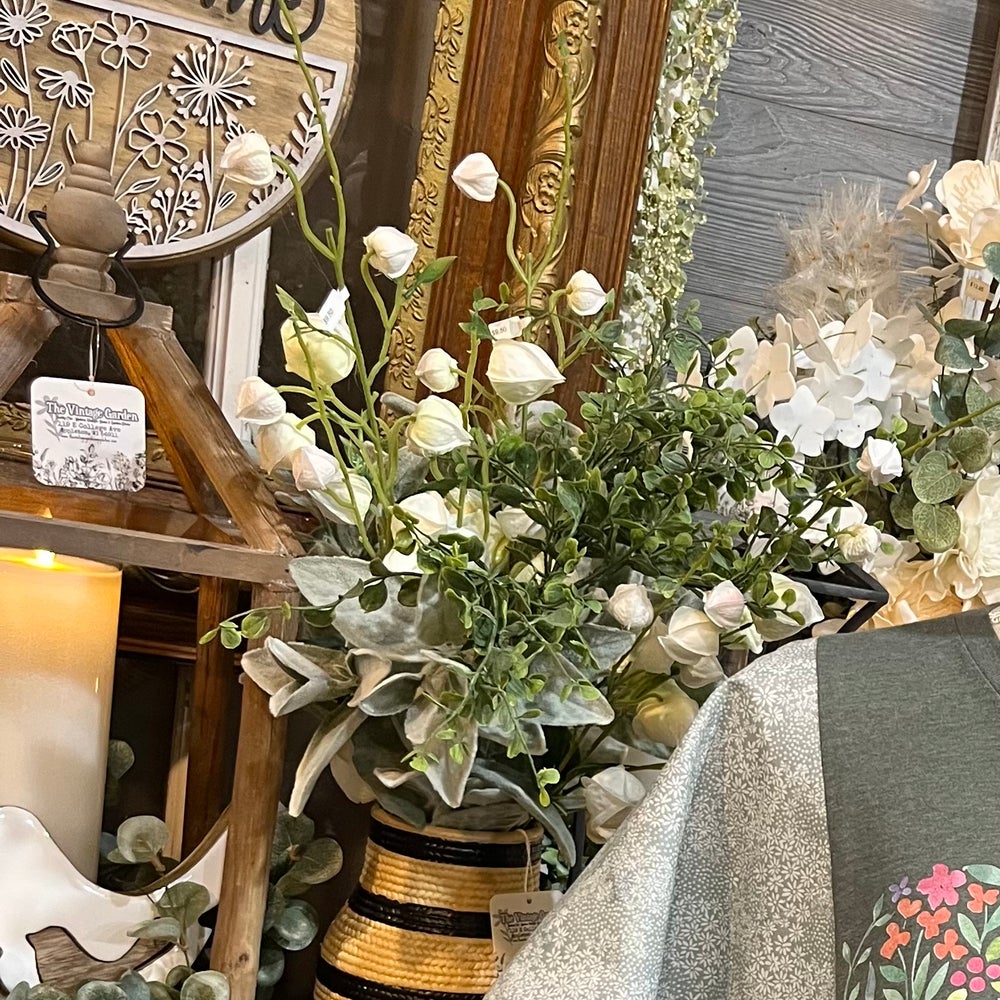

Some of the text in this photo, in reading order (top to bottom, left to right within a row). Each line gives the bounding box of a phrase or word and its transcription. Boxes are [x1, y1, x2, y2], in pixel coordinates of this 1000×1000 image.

[45, 400, 66, 415] The
[66, 402, 104, 419] Vintage
[104, 407, 139, 422] Garden
